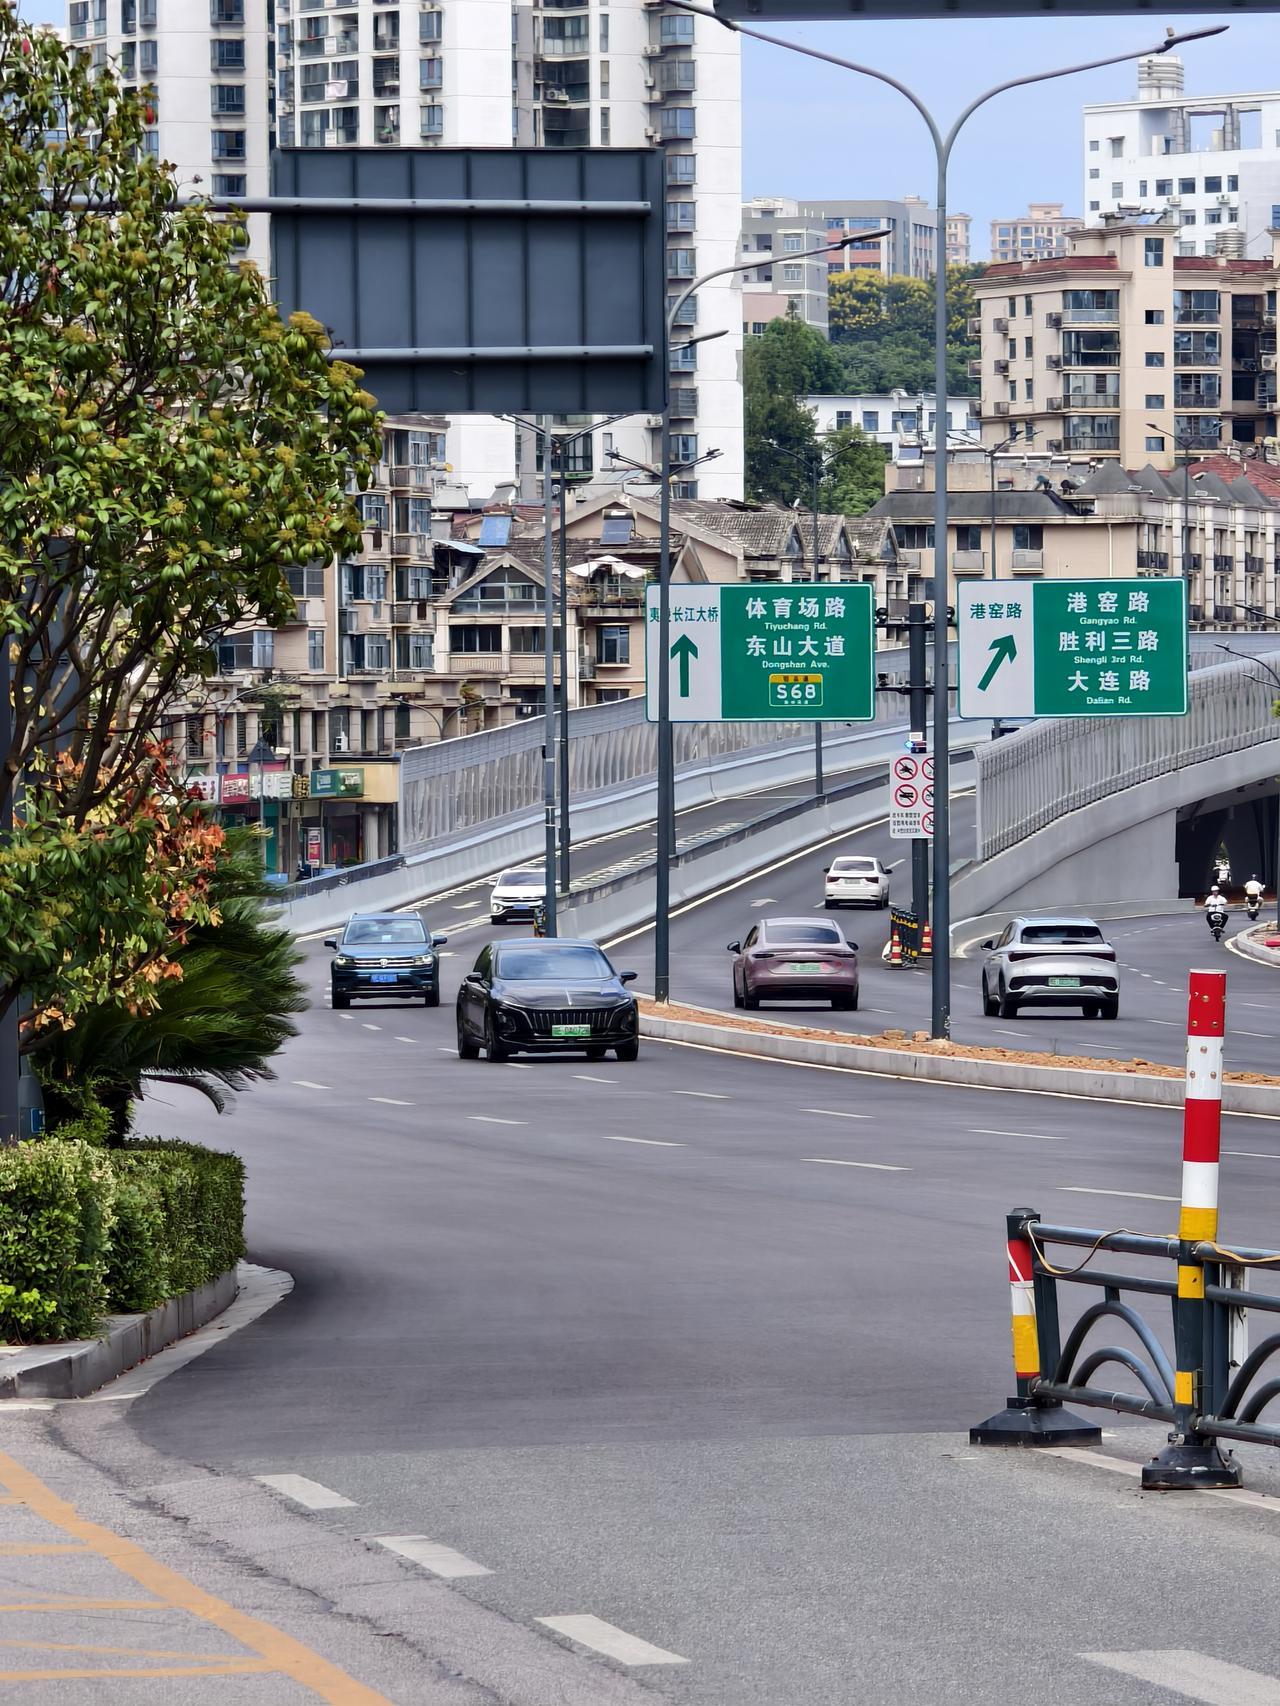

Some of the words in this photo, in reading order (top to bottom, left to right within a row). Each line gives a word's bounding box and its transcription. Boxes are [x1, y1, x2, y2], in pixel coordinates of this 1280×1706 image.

[745, 597, 845, 619] 体育场路
[970, 602, 1022, 619] 港窑路
[1067, 591, 1149, 613] 港窑路
[650, 606, 719, 623] 夷长江大桥
[1080, 617, 1119, 626] Gangyao
[1123, 616, 1137, 624] Rd.
[765, 622, 809, 631] Tiyuchang
[814, 622, 828, 630] Rd.
[746, 635, 845, 656] 东山大道
[1059, 630, 1158, 651] 胜利三路
[762, 660, 806, 669] Dongshan
[810, 660, 830, 668] Ave.
[1074, 655, 1107, 665] Shengli
[1111, 655, 1126, 664] 3rd
[1130, 655, 1144, 664] Rd.
[1067, 670, 1150, 691] 大连路
[776, 684, 816, 699] S68
[1086, 696, 1114, 705] Dalian
[1118, 696, 1132, 704] Rd.
